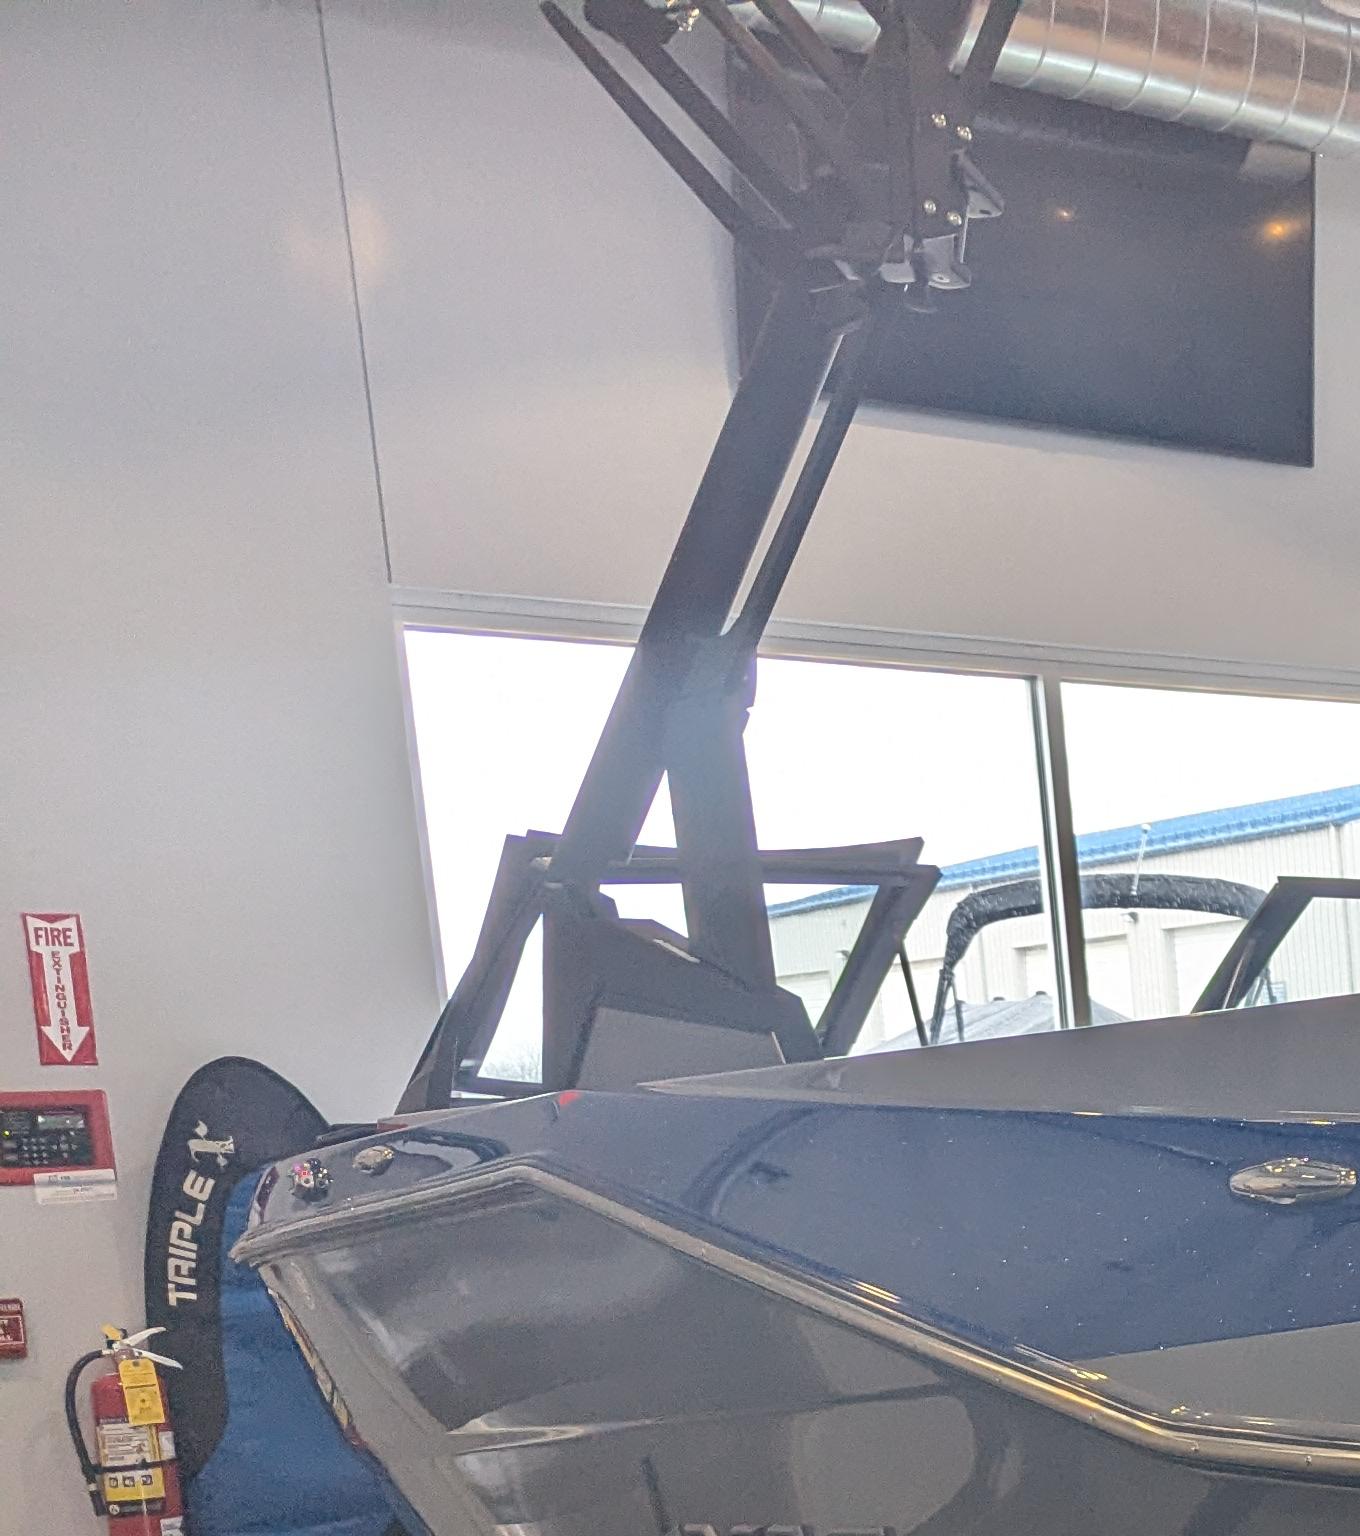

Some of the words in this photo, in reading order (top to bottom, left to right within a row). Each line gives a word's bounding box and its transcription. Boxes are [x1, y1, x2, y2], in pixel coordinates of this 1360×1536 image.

[33, 926, 75, 947] FIRE
[51, 950, 73, 1051] EXTINGUISHER
[167, 1169, 215, 1306] TRIPLE
